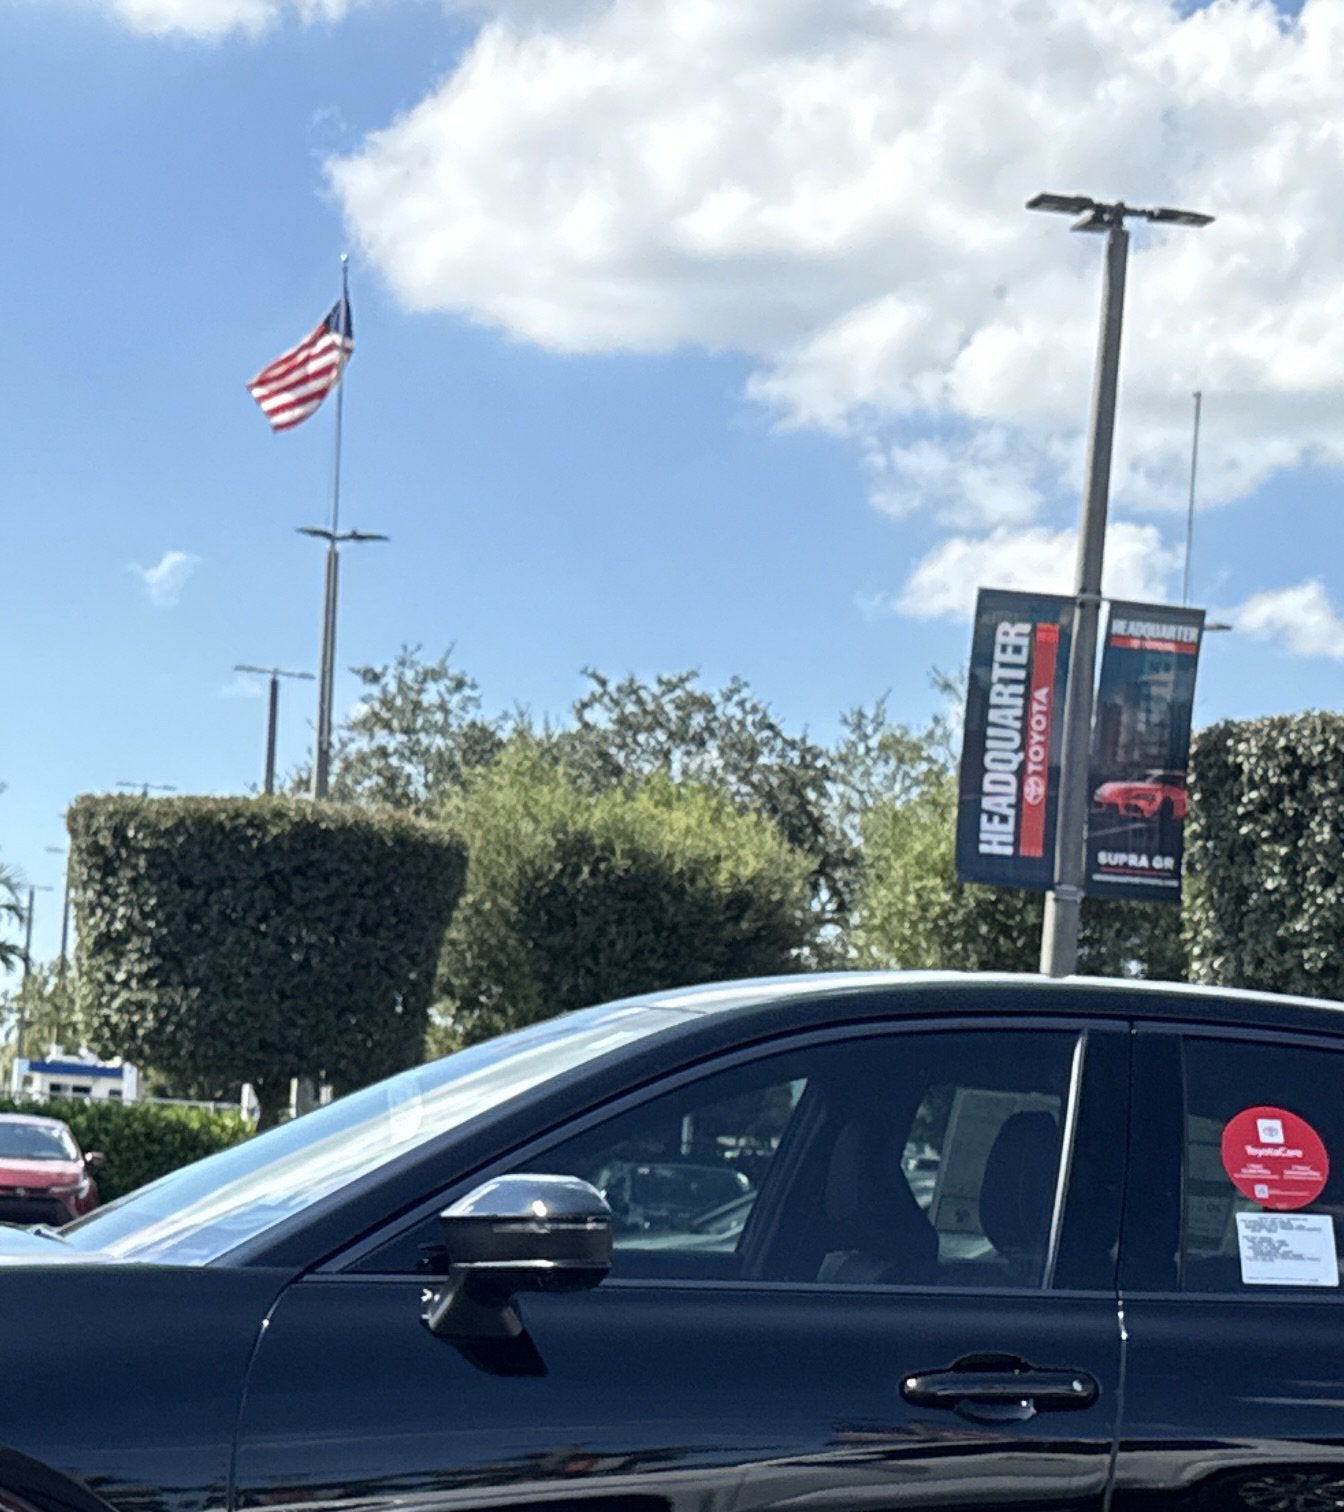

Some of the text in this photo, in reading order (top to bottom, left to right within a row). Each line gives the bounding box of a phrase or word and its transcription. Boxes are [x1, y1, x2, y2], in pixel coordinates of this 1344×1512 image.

[978, 621, 1032, 856] HEADQUARTER
[1027, 686, 1050, 774] TOYOTA
[1097, 851, 1175, 871] SUPRA GR
